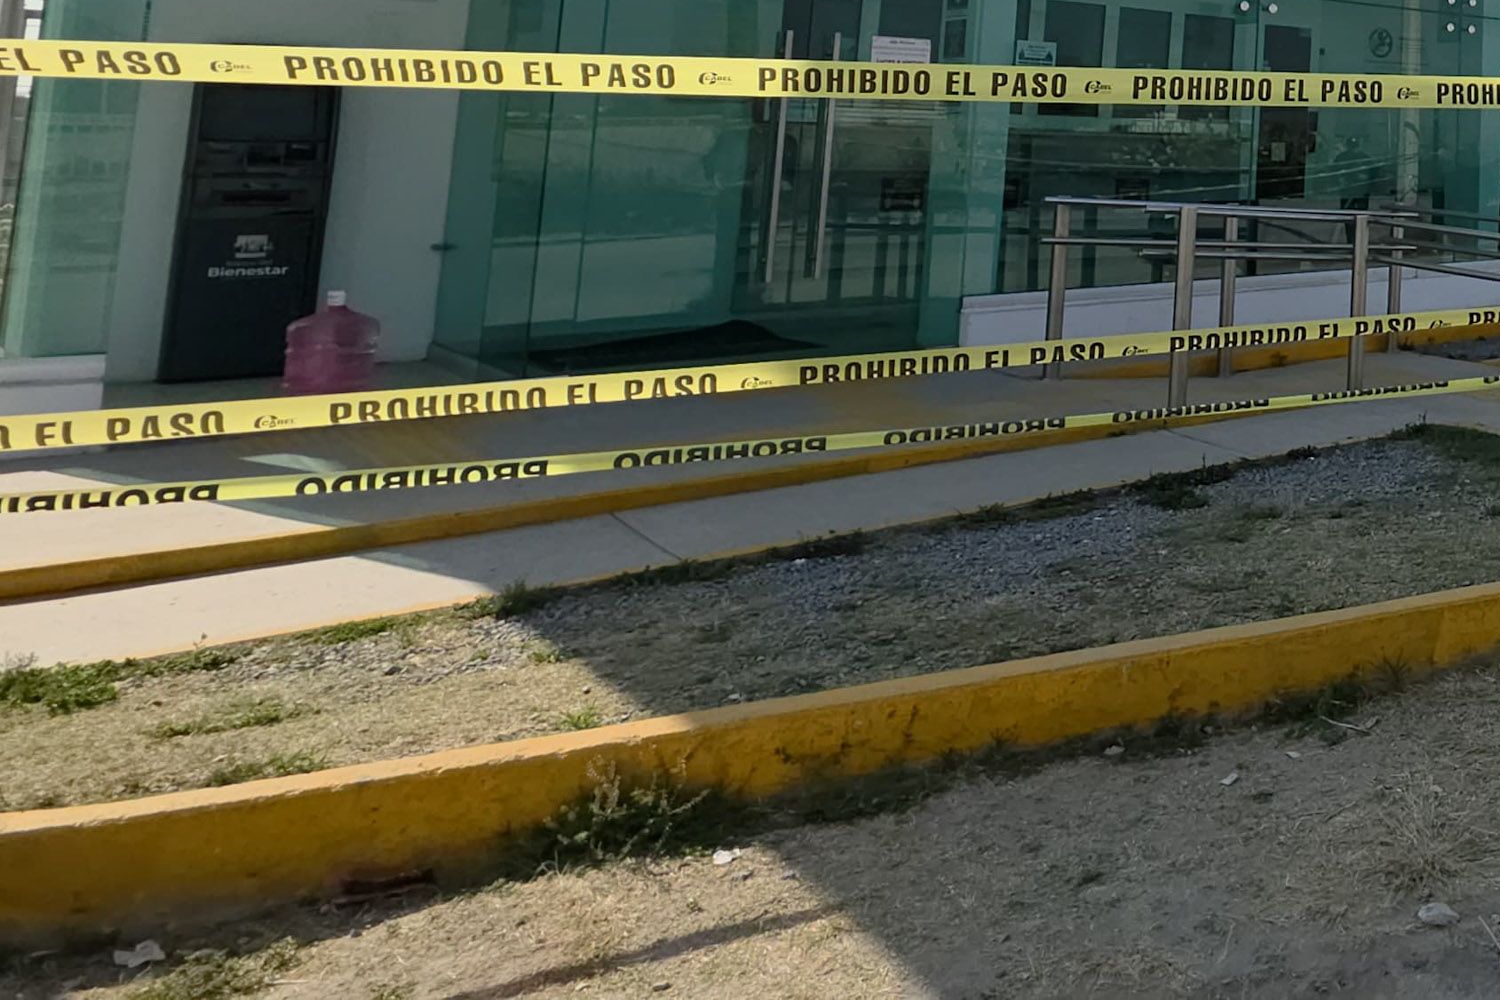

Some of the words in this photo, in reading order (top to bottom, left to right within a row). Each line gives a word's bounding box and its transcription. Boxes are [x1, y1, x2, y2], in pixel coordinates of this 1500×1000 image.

[0, 47, 42, 72] EL
[58, 49, 182, 76] PASO
[283, 55, 505, 86] PROHIBIDO
[523, 61, 562, 87] EL
[581, 62, 676, 89] PASO
[758, 67, 931, 96] PROHIBIDO
[945, 71, 976, 96] EL
[991, 73, 1068, 98] PASO
[1132, 75, 1272, 102] PROHIBIDO
[1284, 79, 1309, 102] EL
[1321, 79, 1384, 104] PASO
[207, 265, 289, 278] Bienestar
[1169, 325, 1306, 353] PROHIBIDO
[1319, 324, 1340, 339] EL
[1354, 317, 1416, 336] PASO
[800, 353, 970, 385] PROHIBIDO
[985, 350, 1010, 369] EL
[1030, 342, 1105, 365] PASO
[329, 387, 547, 424] PROHIBIDO
[566, 383, 597, 404] EL
[624, 373, 718, 401] PASO
[34, 420, 73, 447] EL
[106, 411, 225, 442] PASO
